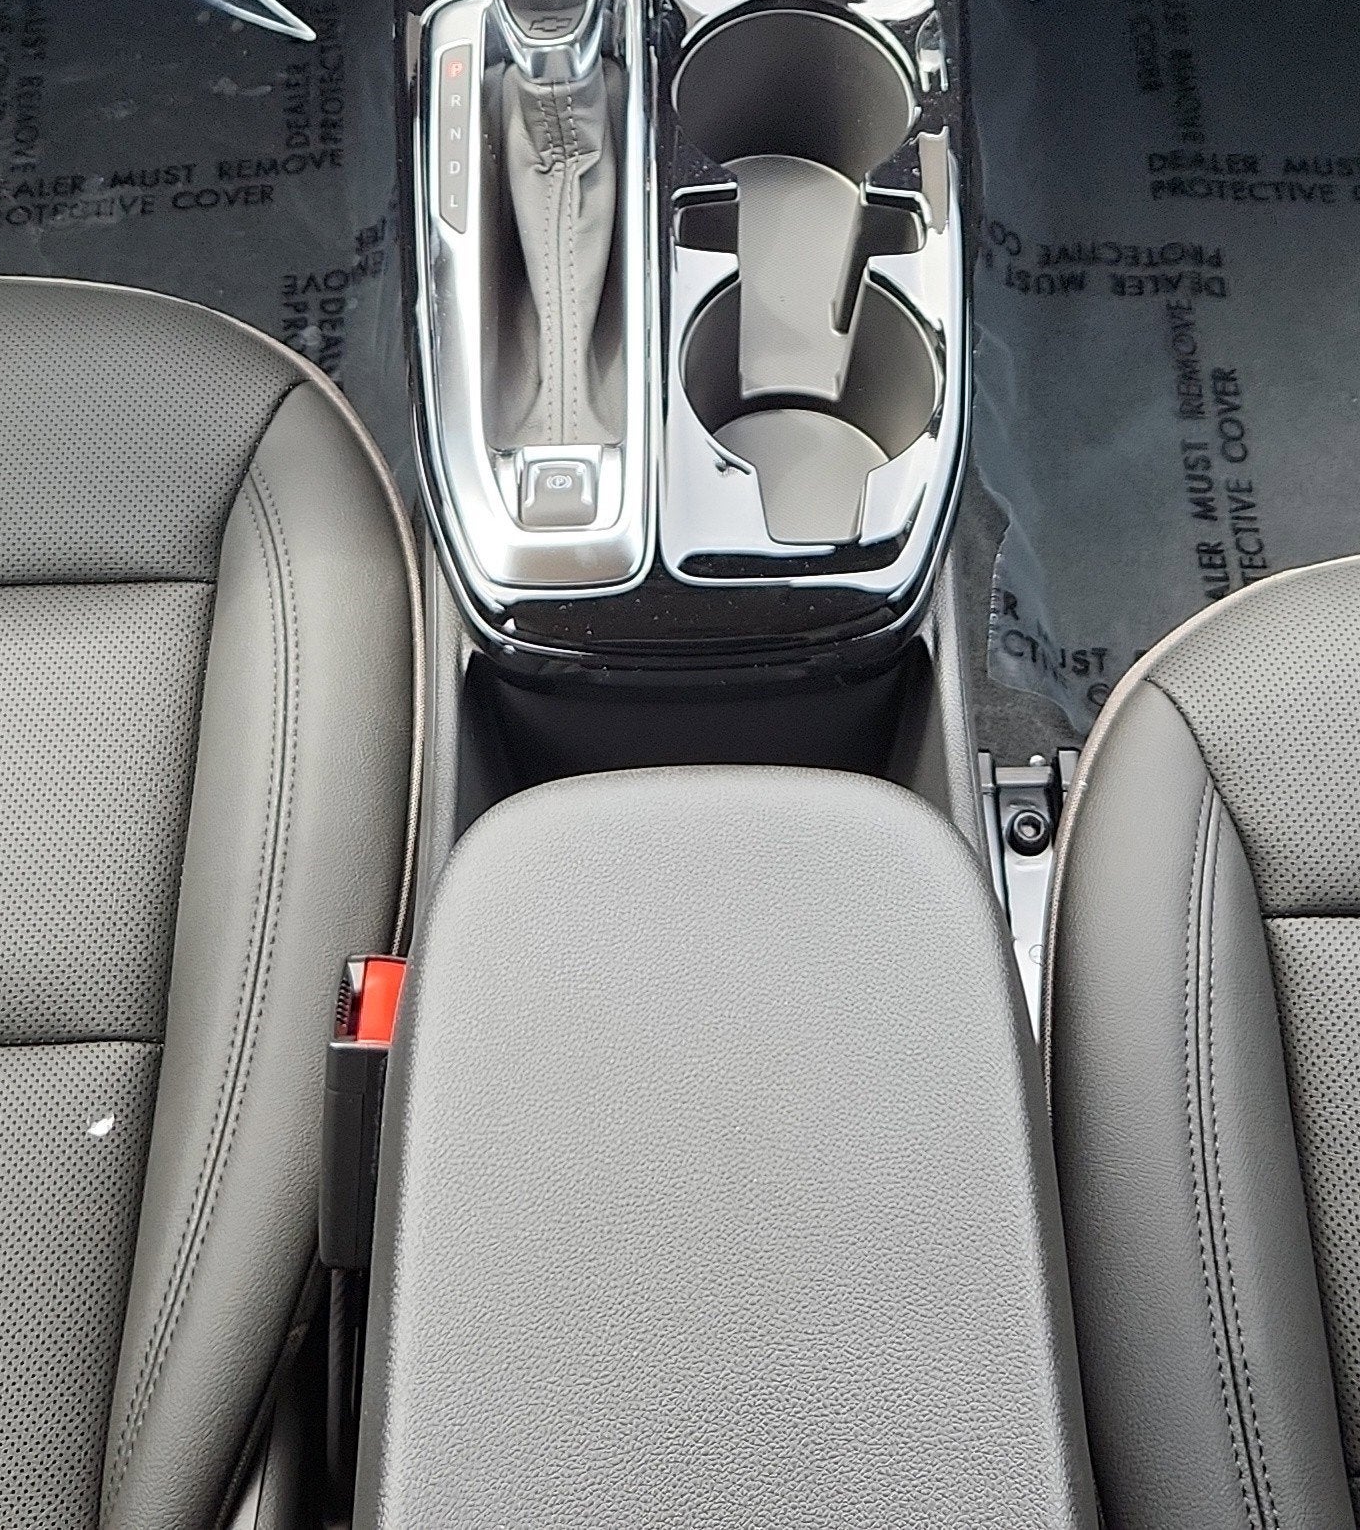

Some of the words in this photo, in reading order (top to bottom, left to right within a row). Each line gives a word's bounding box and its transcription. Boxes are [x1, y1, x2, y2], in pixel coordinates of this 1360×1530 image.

[450, 61, 463, 78] P
[283, 60, 312, 152] DEALER
[450, 93, 463, 108] R
[449, 127, 462, 141] N
[108, 162, 200, 191] MUST
[216, 147, 343, 182] REMOVE
[449, 160, 462, 175] D
[1146, 152, 1261, 177] DEALER
[171, 184, 275, 212] COVER
[449, 194, 459, 208] L
[1150, 177, 1337, 205] PROTECTIVE
[1038, 241, 1224, 270] PROTECTIVE
[1004, 265, 1087, 297] MUST
[1108, 270, 1229, 300] DEALER
[1165, 297, 1206, 422] REMOVE
[1211, 367, 1252, 464] COVER
[1180, 439, 1213, 522] MUST
[1226, 478, 1269, 588] TECTIVE
[1203, 539, 1230, 601] ALER
